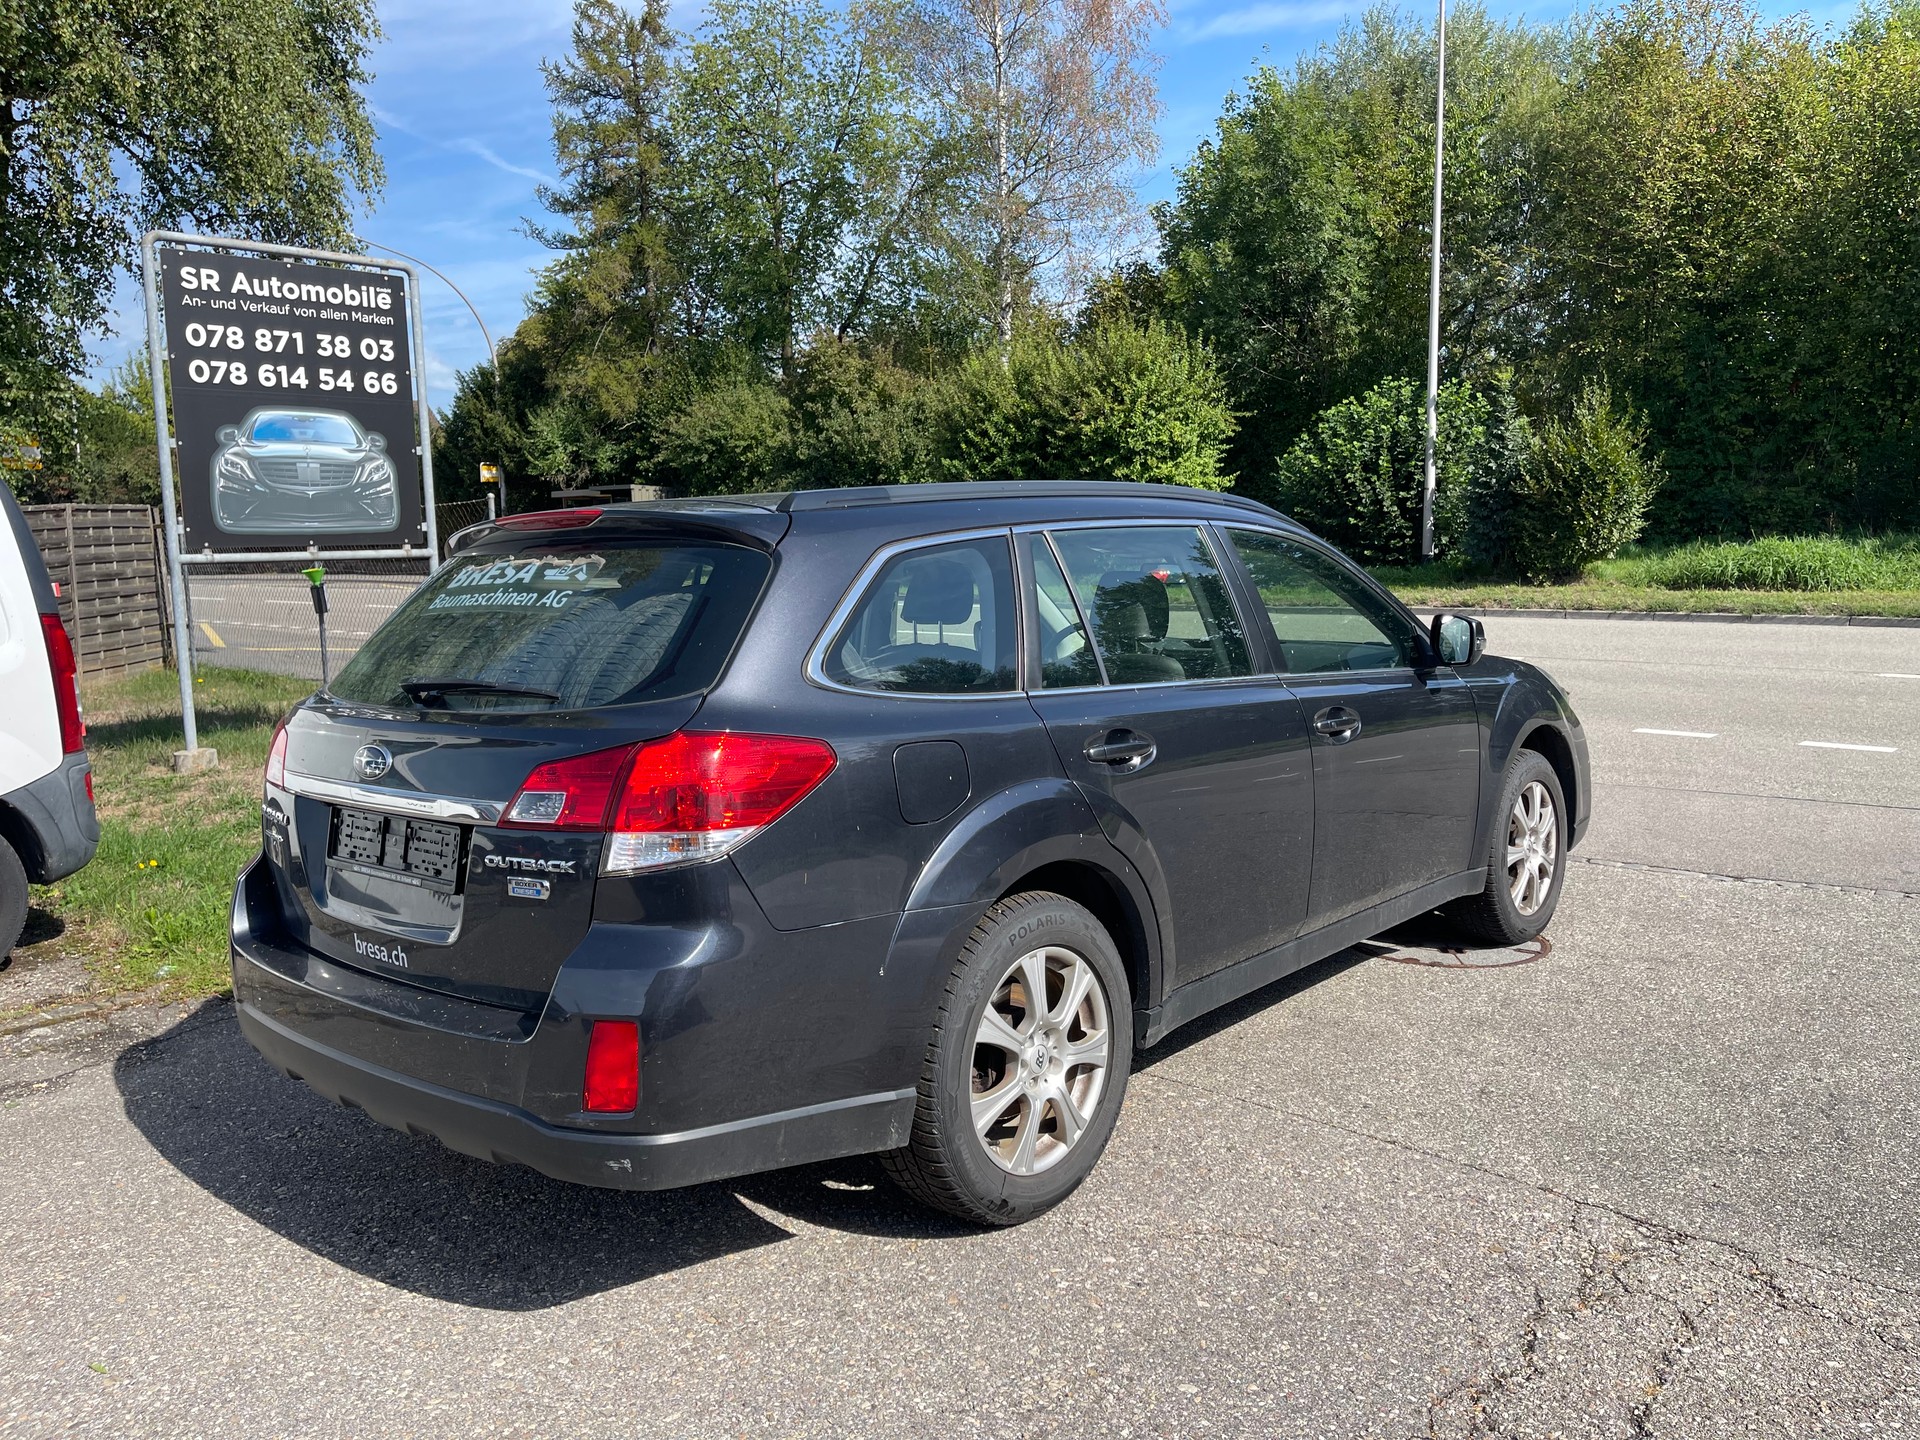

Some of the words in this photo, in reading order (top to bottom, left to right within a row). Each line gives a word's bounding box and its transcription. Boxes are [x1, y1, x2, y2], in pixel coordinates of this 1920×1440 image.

[180, 266, 220, 292] SR
[231, 272, 391, 310] Automobile
[182, 294, 207, 307] An-
[211, 298, 237, 310] und
[240, 300, 290, 315] Verkauf
[294, 308, 316, 318] von
[320, 308, 348, 321] allen
[352, 311, 394, 326] Marken
[185, 323, 245, 350] 078
[255, 329, 304, 355] 871
[316, 334, 350, 358] 38
[360, 338, 394, 362] 03
[188, 359, 248, 385] 078
[258, 365, 308, 389] 614
[319, 368, 354, 392] 54
[363, 372, 397, 395] 66
[447, 562, 540, 589] BRESA
[428, 588, 538, 610] Baumaschinen
[536, 590, 573, 608] AG
[484, 855, 576, 874] OUTBACK
[514, 880, 538, 888] BOXER
[514, 888, 539, 896] DIESEL
[1008, 914, 1066, 947] POLARIS
[353, 933, 408, 968] bresa.ch
